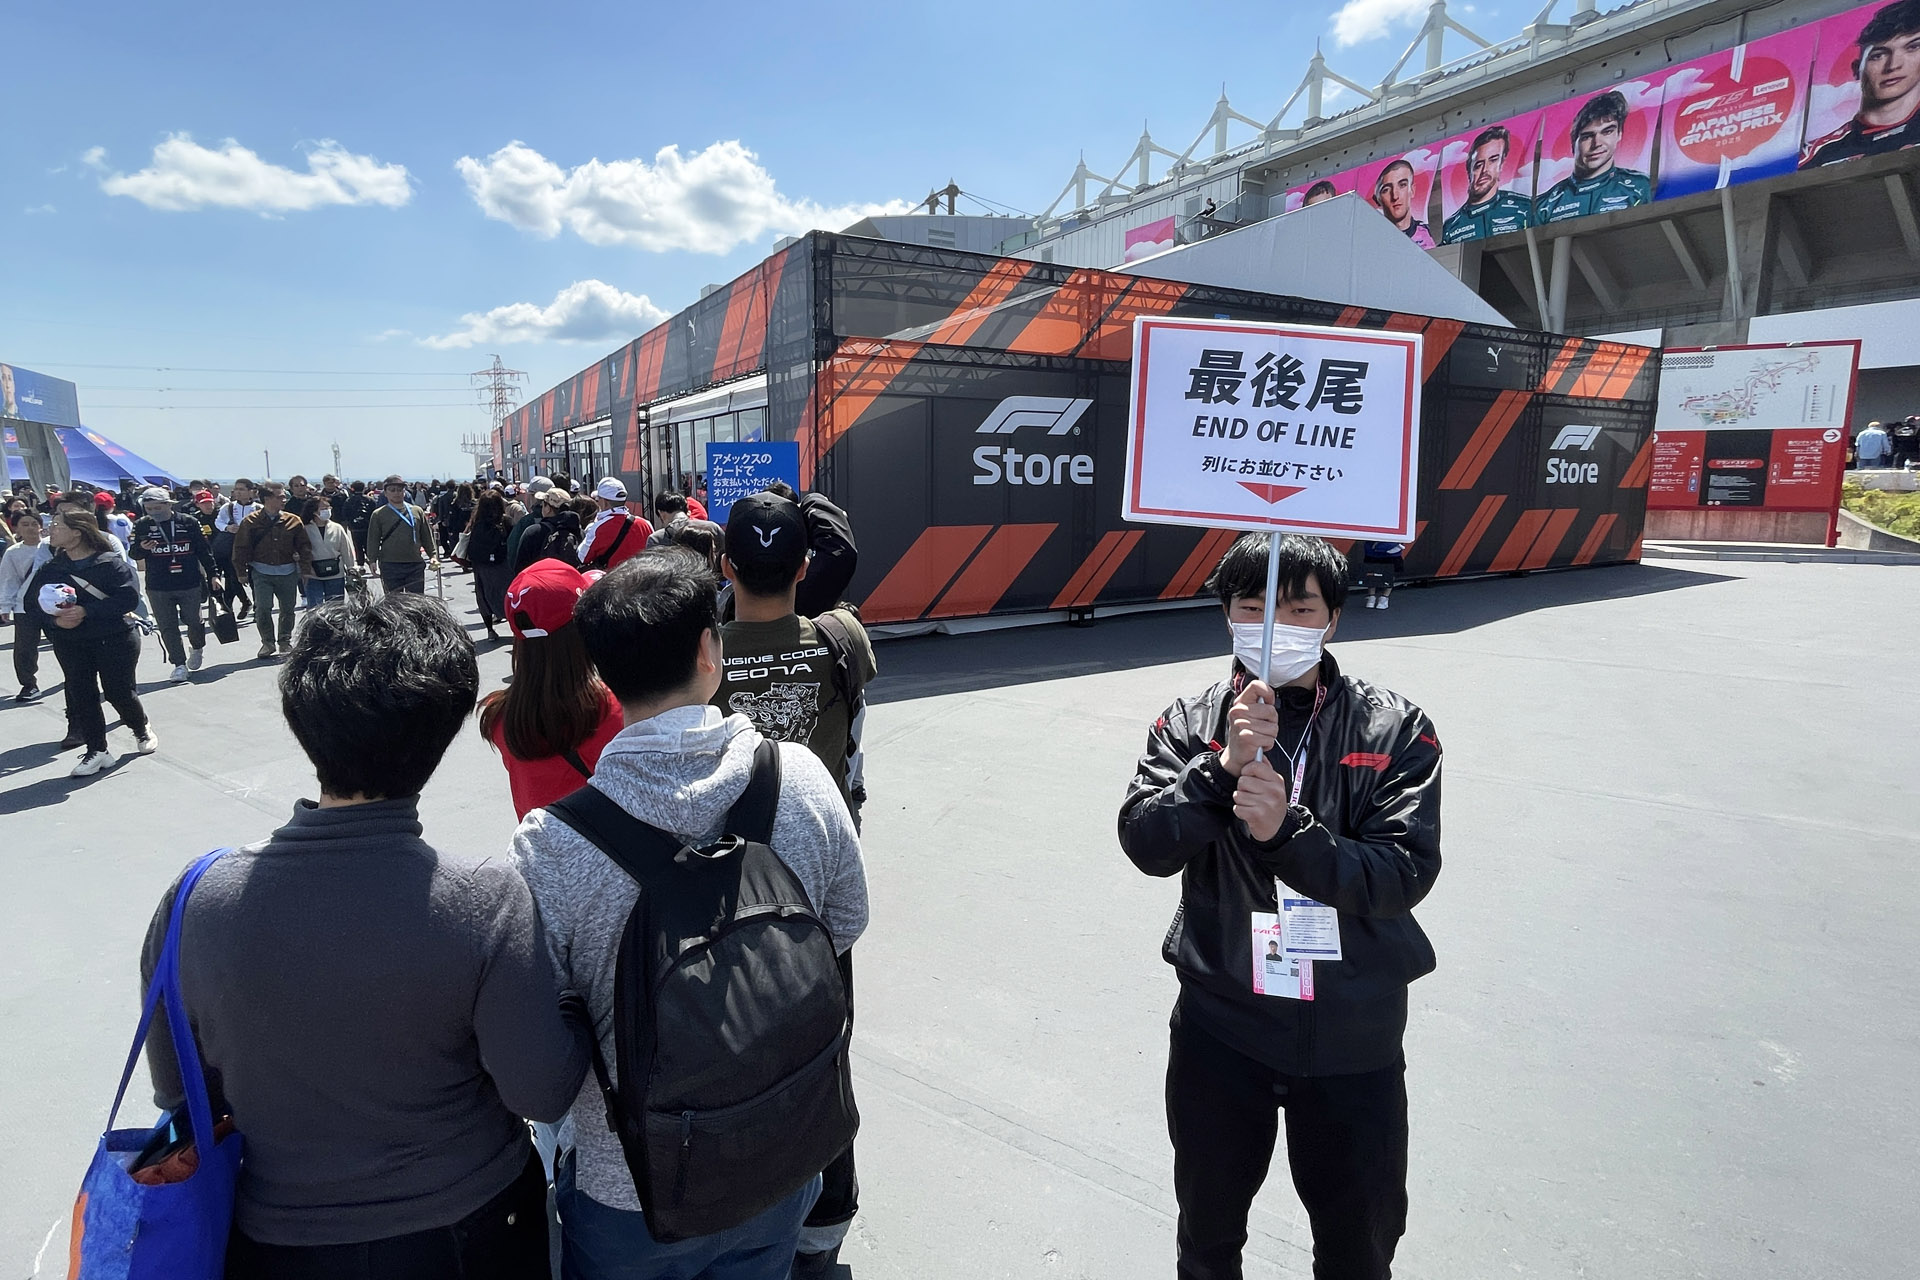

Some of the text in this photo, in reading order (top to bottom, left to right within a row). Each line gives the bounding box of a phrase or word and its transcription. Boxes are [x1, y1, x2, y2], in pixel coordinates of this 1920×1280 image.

[1755, 81, 1786, 94] Lenovo
[1680, 112, 1784, 147] GRAND PRIX
[1687, 102, 1776, 134] JAPANESE
[1715, 136, 1741, 147] 2025
[1185, 349, 1369, 415] 最後尾
[975, 396, 1094, 435] F1
[1192, 415, 1356, 449] END OF LINE
[712, 453, 773, 465] アメックスの
[713, 465, 755, 477] カードで
[973, 446, 1094, 485] Store
[1201, 455, 1344, 482] 列にお並び下さい
[1545, 458, 1599, 484] Store
[171, 543, 190, 553] Bull
[722, 647, 829, 666] NGINE CODE
